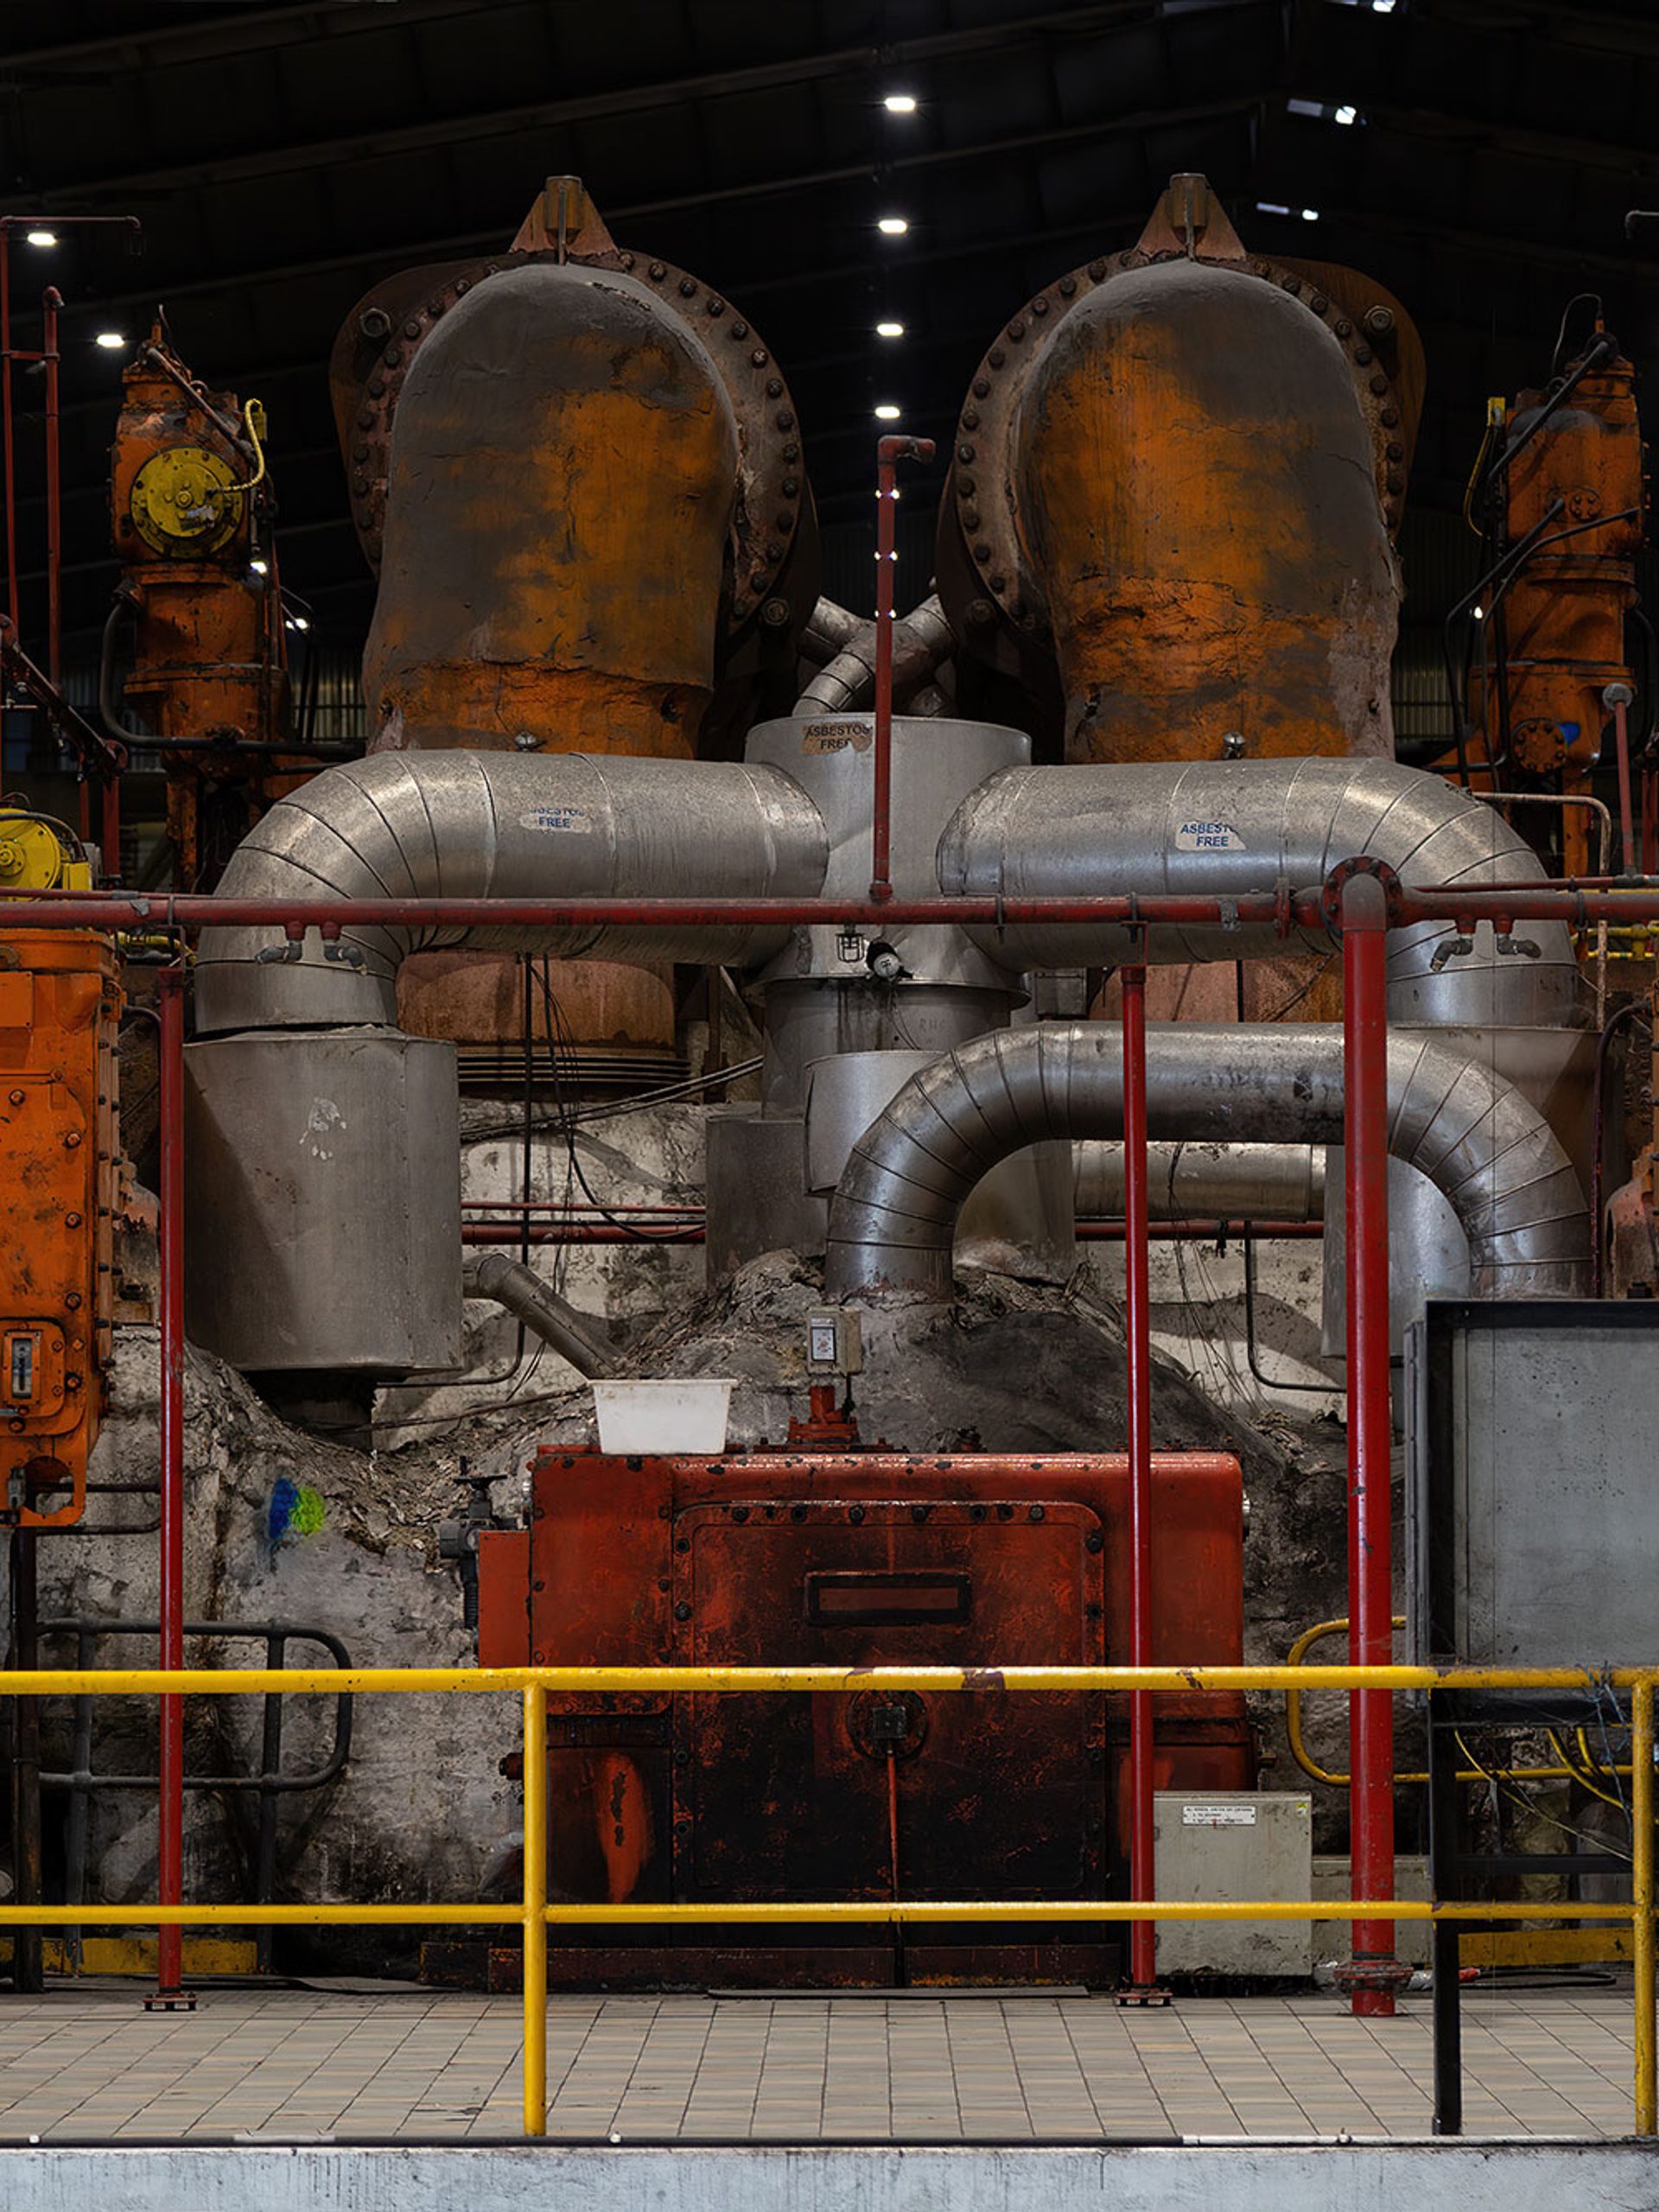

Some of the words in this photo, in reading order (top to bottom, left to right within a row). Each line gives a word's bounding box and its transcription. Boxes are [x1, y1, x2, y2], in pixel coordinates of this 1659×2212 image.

[804, 724, 873, 740] ASBESTOS
[538, 817, 570, 828] FREE
[1196, 836, 1229, 847] FREE
